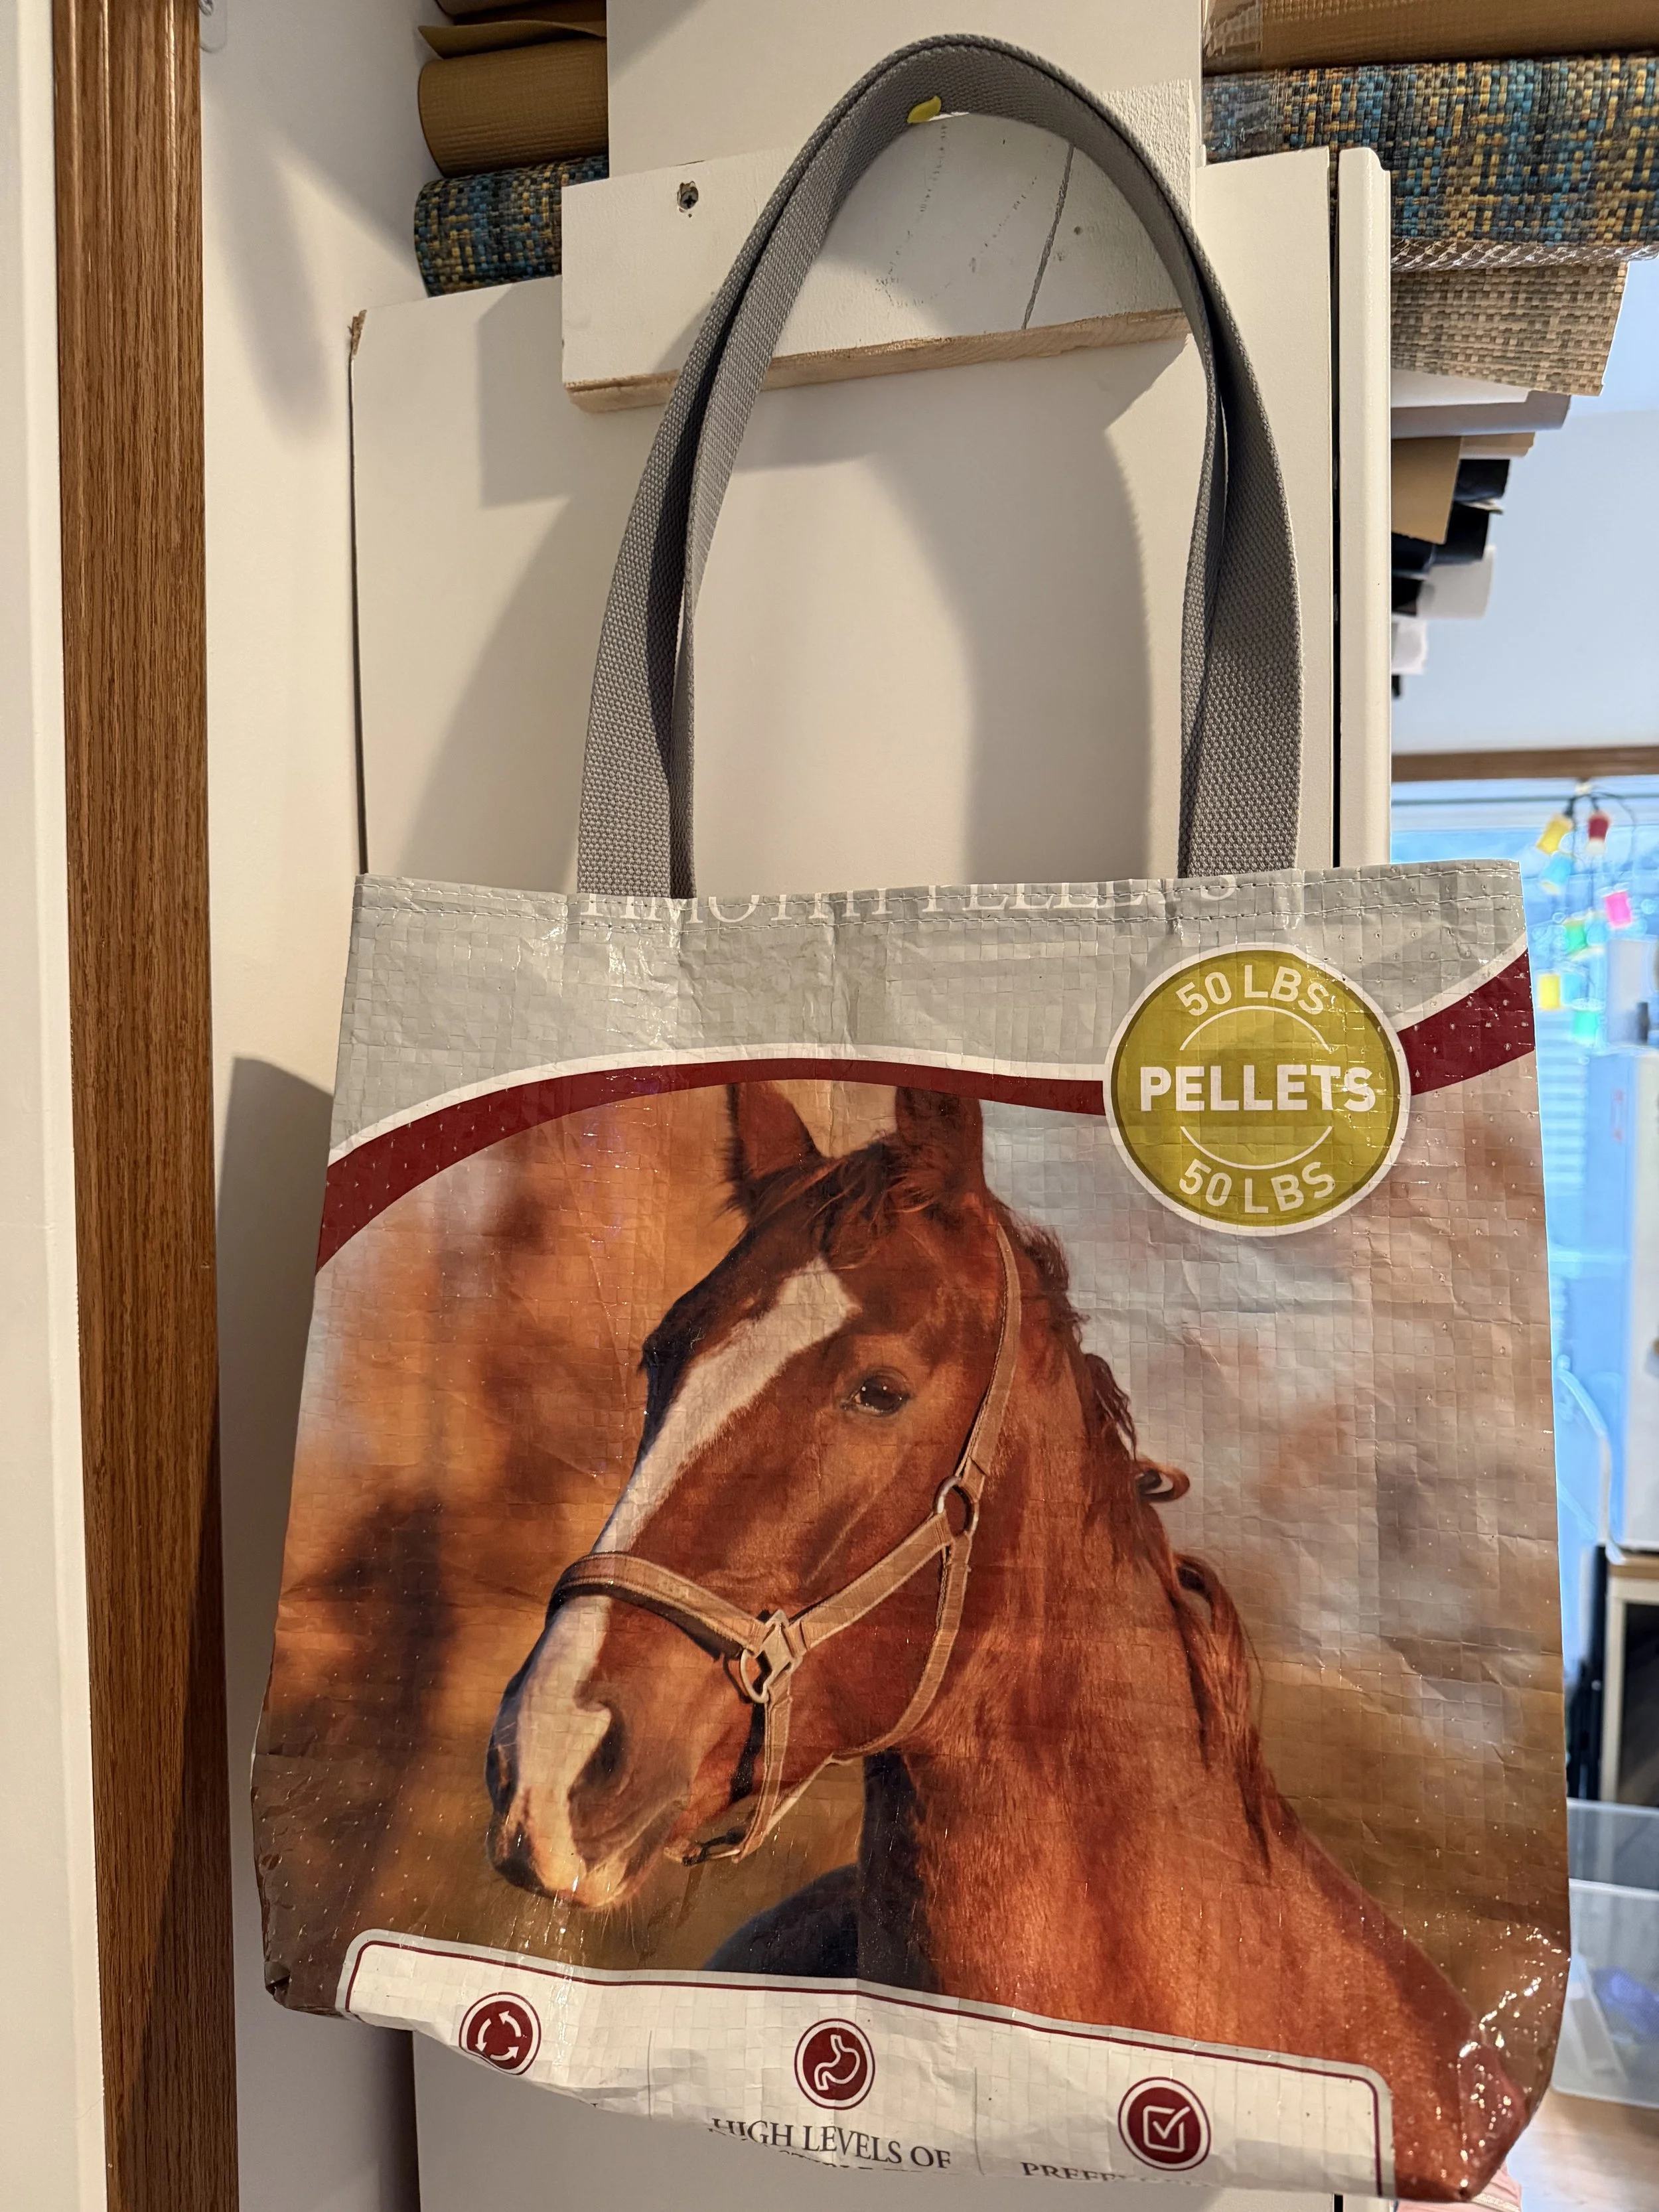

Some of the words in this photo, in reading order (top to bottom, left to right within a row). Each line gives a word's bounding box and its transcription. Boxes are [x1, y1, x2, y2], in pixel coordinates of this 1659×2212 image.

[1176, 972, 1232, 1016] 50
[1244, 965, 1330, 1015] LBS
[1140, 1064, 1376, 1112] PELLETS
[1179, 1159, 1232, 1207] 50
[1244, 1161, 1335, 1215] LBS
[802, 2124, 902, 2164] LEVELS
[910, 2145, 951, 2170] OF
